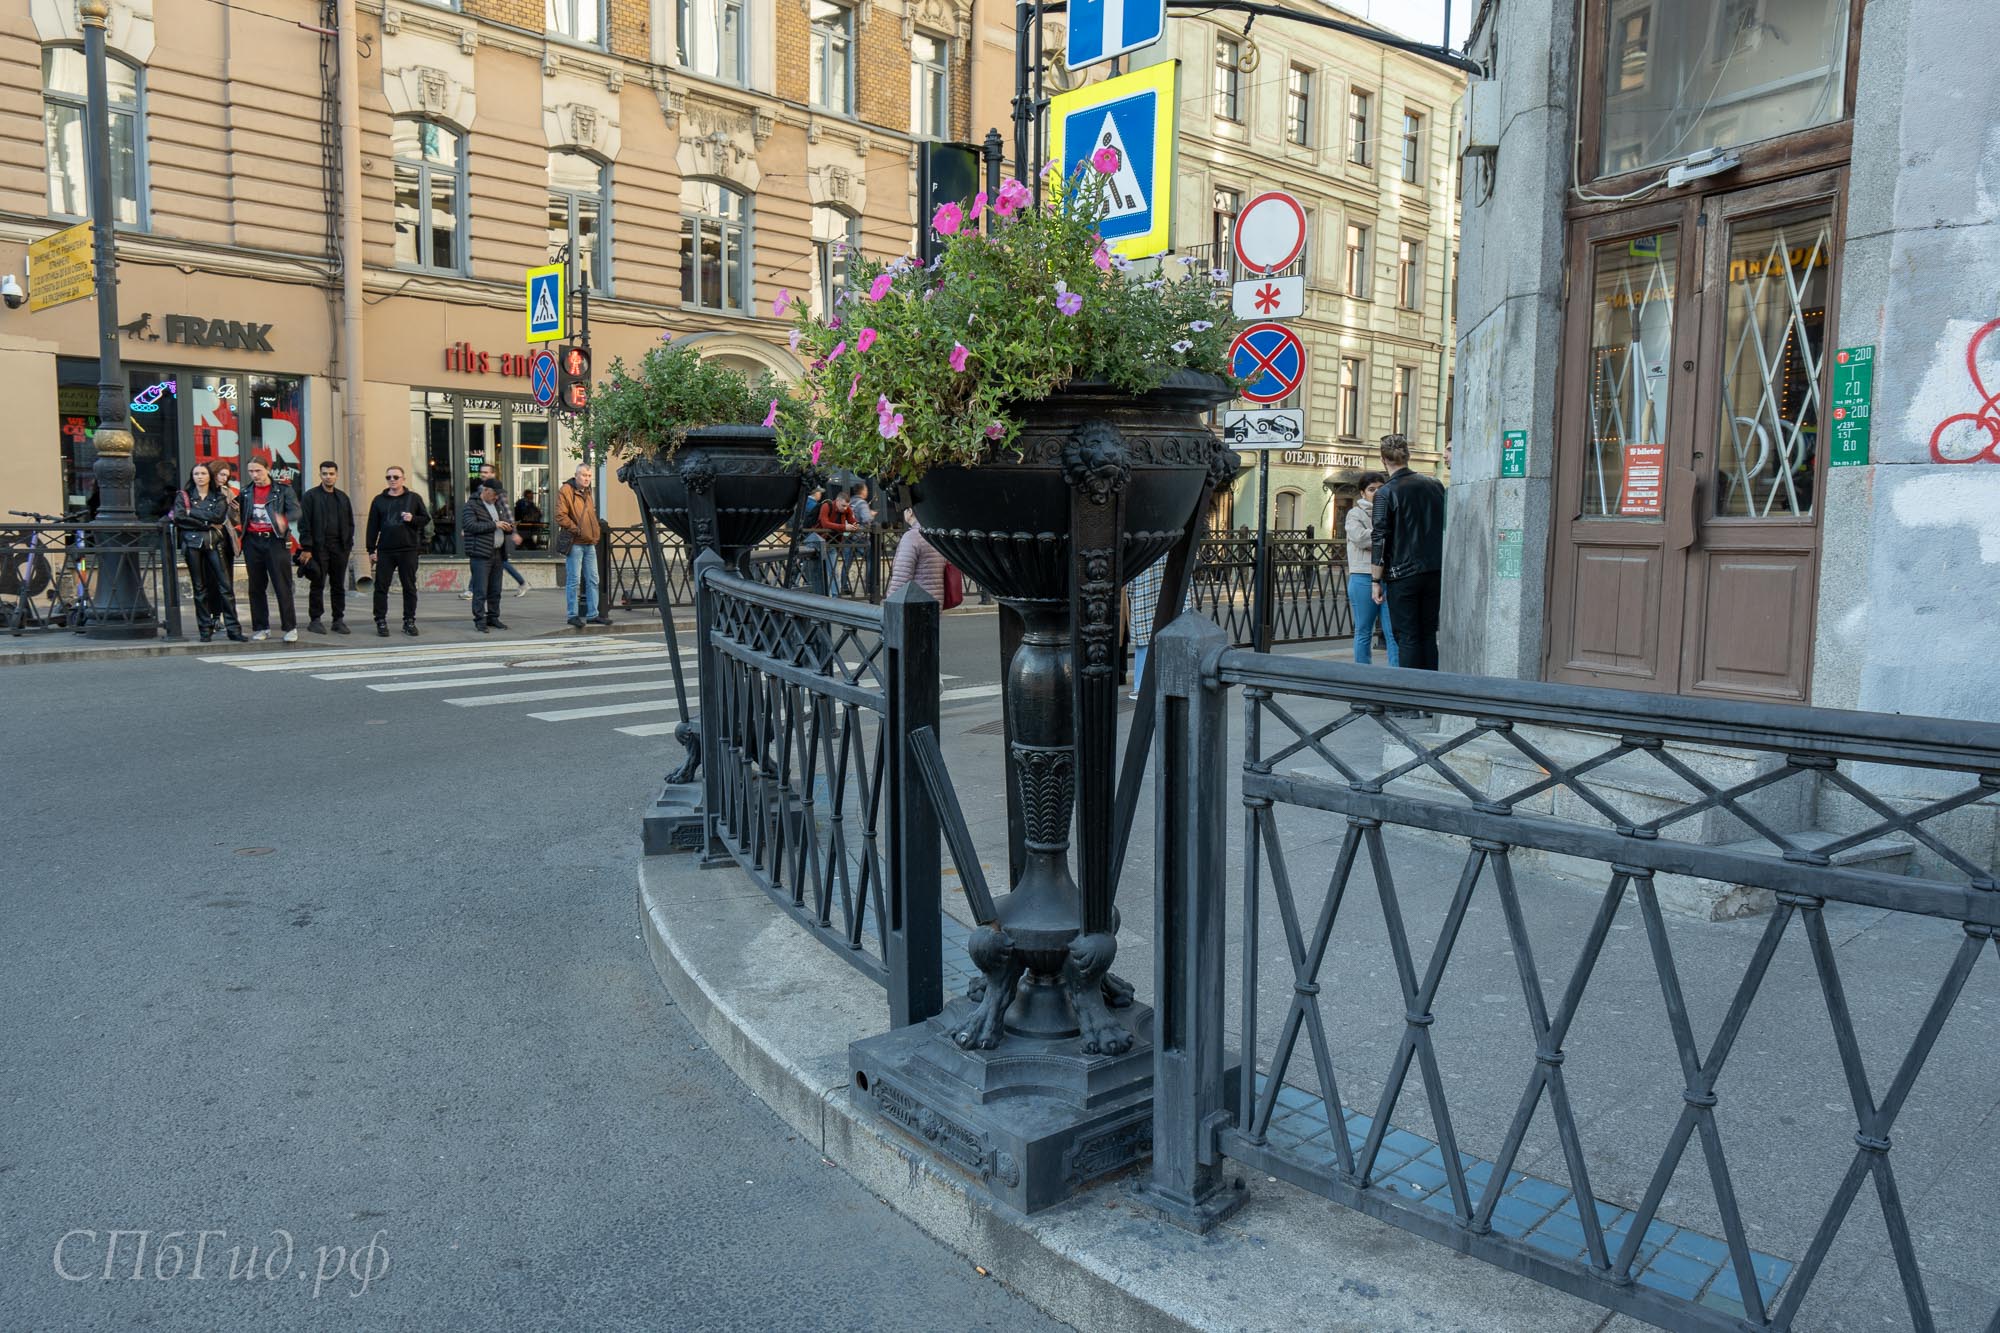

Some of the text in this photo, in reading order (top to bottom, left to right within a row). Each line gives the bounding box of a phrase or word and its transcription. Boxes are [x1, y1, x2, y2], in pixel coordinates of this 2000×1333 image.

[166, 314, 275, 352] FRANK
[446, 342, 490, 373] ribs
[1285, 450, 1365, 467] ОТЕЛЬ ДИНАСТИЯ
